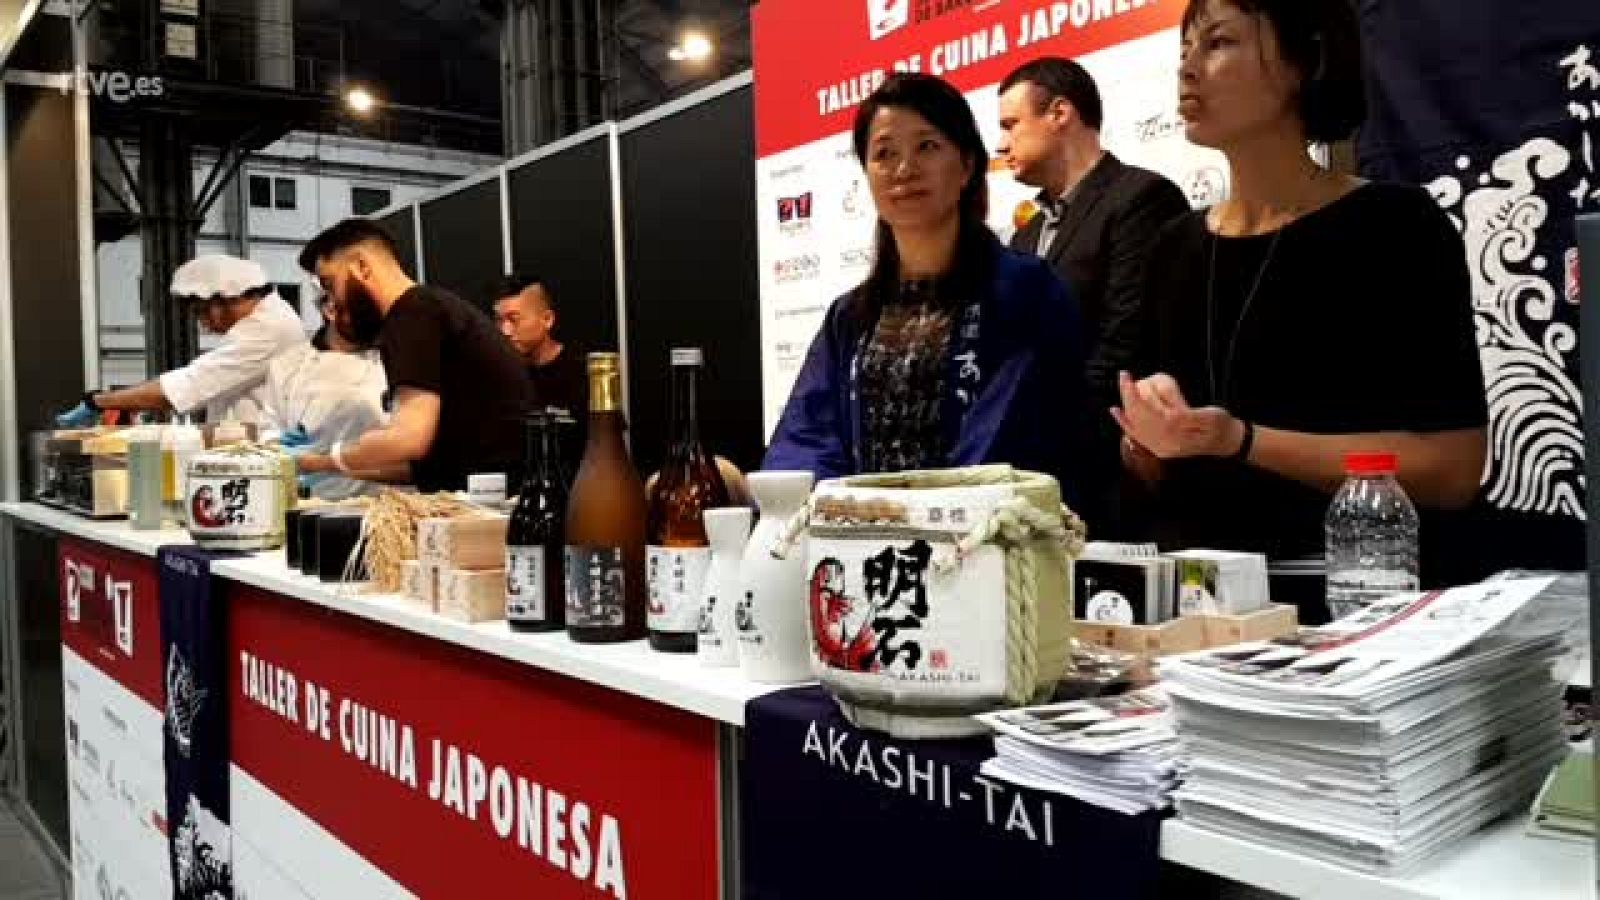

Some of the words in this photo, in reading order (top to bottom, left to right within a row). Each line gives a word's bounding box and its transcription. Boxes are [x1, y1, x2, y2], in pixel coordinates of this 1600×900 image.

[930, 22, 1007, 76] CUINA
[1017, 0, 1158, 47] JAPON
[863, 539, 932, 670] 明石
[239, 650, 299, 724] TALLER
[304, 679, 331, 741] DE
[338, 699, 418, 789] CUINA
[429, 739, 628, 900] JAPONESA
[802, 719, 1054, 847] AKASHI-TAI
